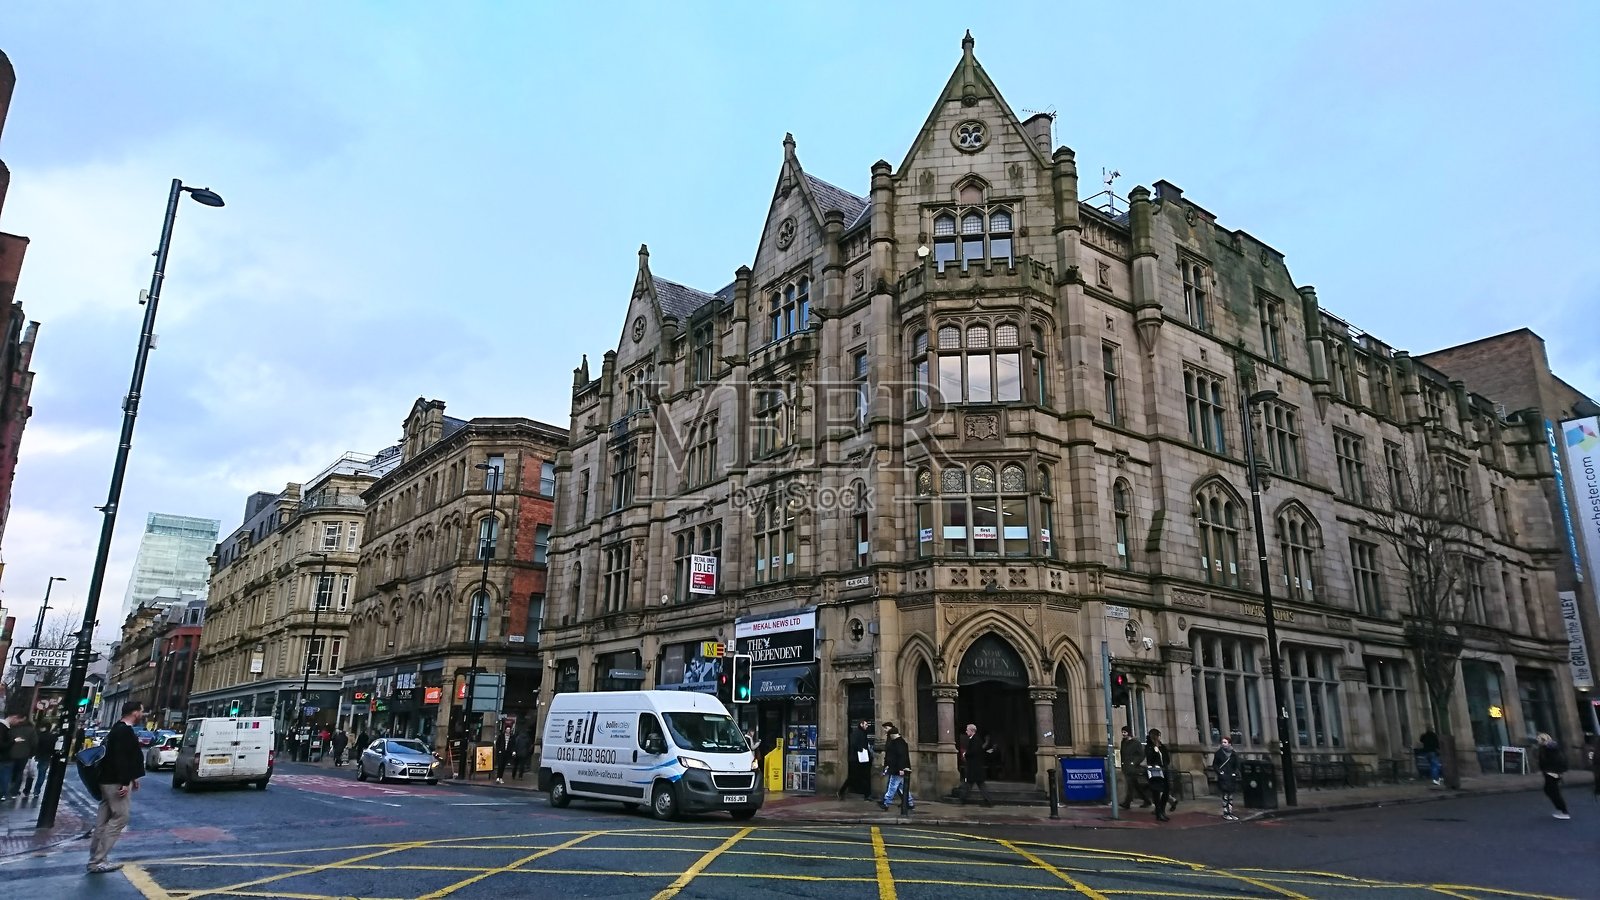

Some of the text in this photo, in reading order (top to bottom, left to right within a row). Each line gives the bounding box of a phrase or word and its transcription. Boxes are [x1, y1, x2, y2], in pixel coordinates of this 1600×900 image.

[1552, 451, 1563, 478] LET
[694, 563, 714, 573] TO LET
[752, 622, 771, 631] MEKAL
[772, 620, 789, 628] NEWS
[790, 617, 801, 626] LTD
[747, 638, 763, 651] THE
[1561, 598, 1589, 680] the GRILL on the ALLEY
[31, 650, 68, 658] BRIDGE
[29, 658, 67, 666] STREET
[974, 657, 1009, 669] OPEN
[557, 747, 616, 764] 0161 798 9600
[578, 769, 623, 779] www.bollin-valley.co.uk
